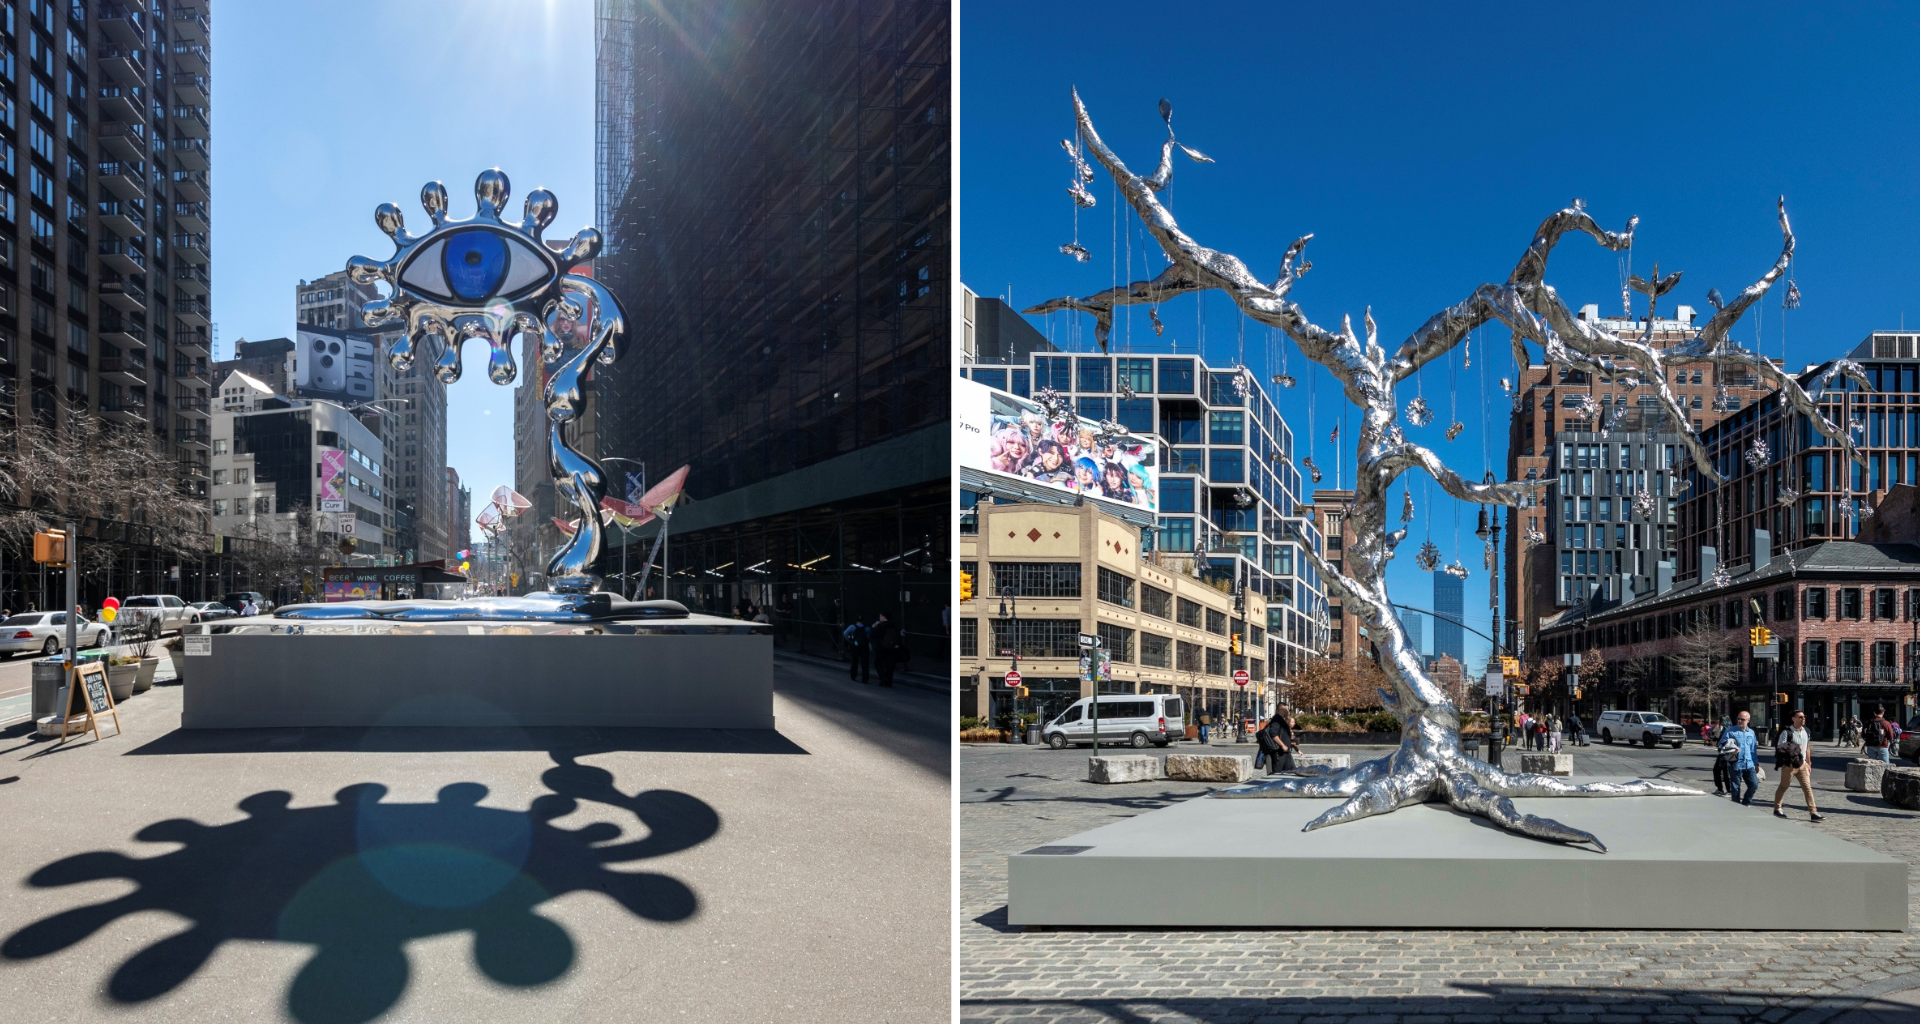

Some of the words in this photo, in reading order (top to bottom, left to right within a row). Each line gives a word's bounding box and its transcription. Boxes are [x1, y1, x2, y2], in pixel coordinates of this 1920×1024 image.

[346, 339, 373, 397] PRO
[965, 423, 980, 433] Pro
[341, 524, 352, 533] 10
